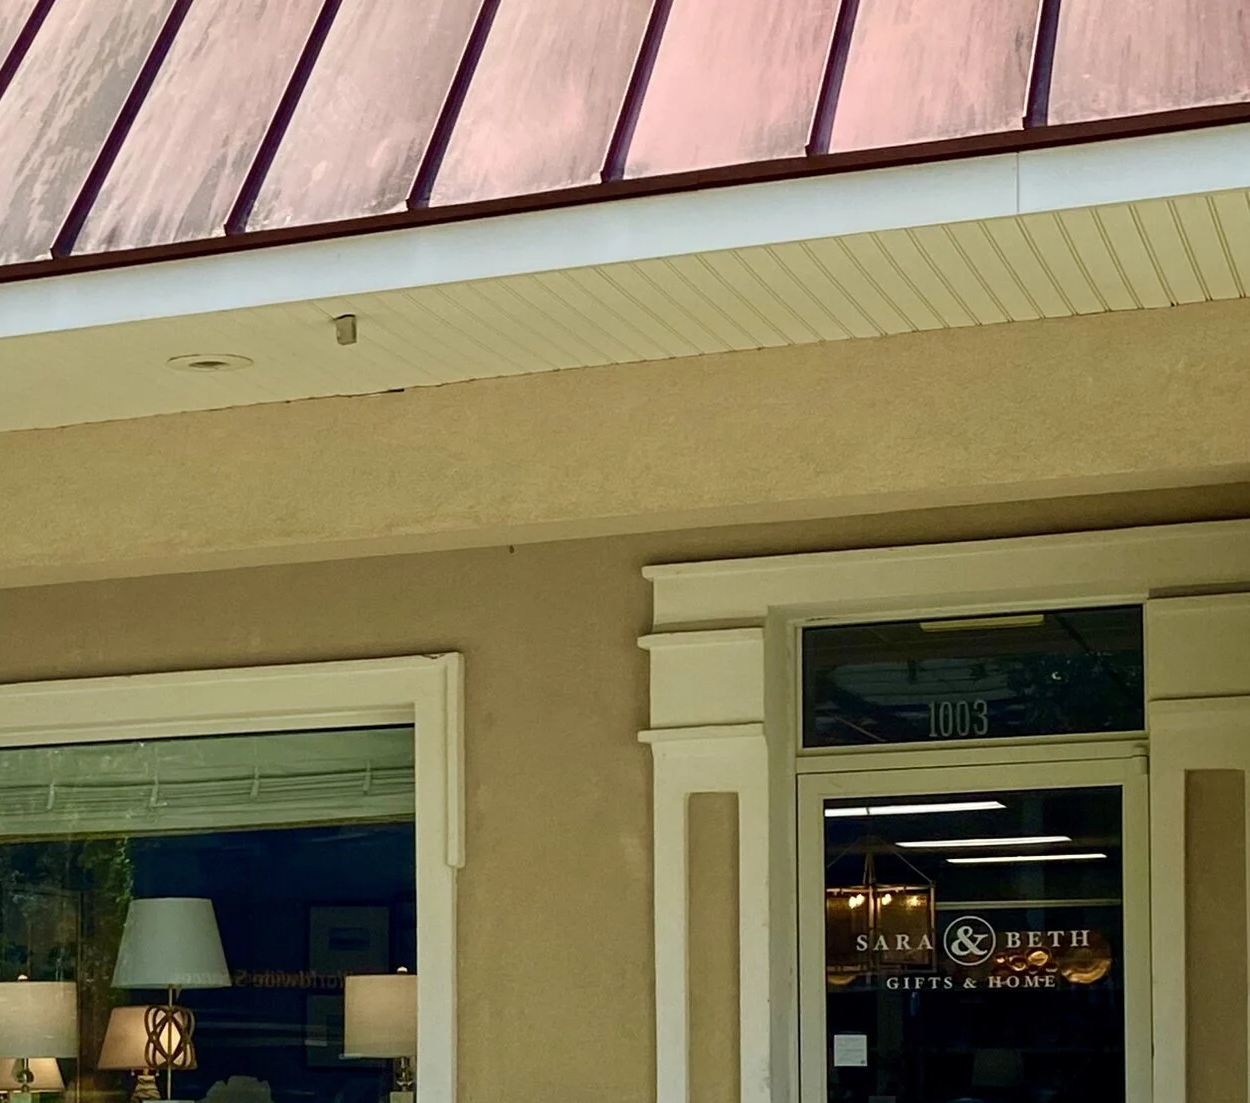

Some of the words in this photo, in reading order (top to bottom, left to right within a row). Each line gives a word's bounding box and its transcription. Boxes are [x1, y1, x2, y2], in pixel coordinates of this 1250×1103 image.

[929, 700, 989, 737] 1003
[856, 934, 934, 951] SARA
[950, 925, 989, 957] &
[1006, 929, 1090, 948] BETH
[886, 976, 953, 991] GIFTS
[962, 976, 978, 990] &
[988, 975, 1056, 989] HOME
